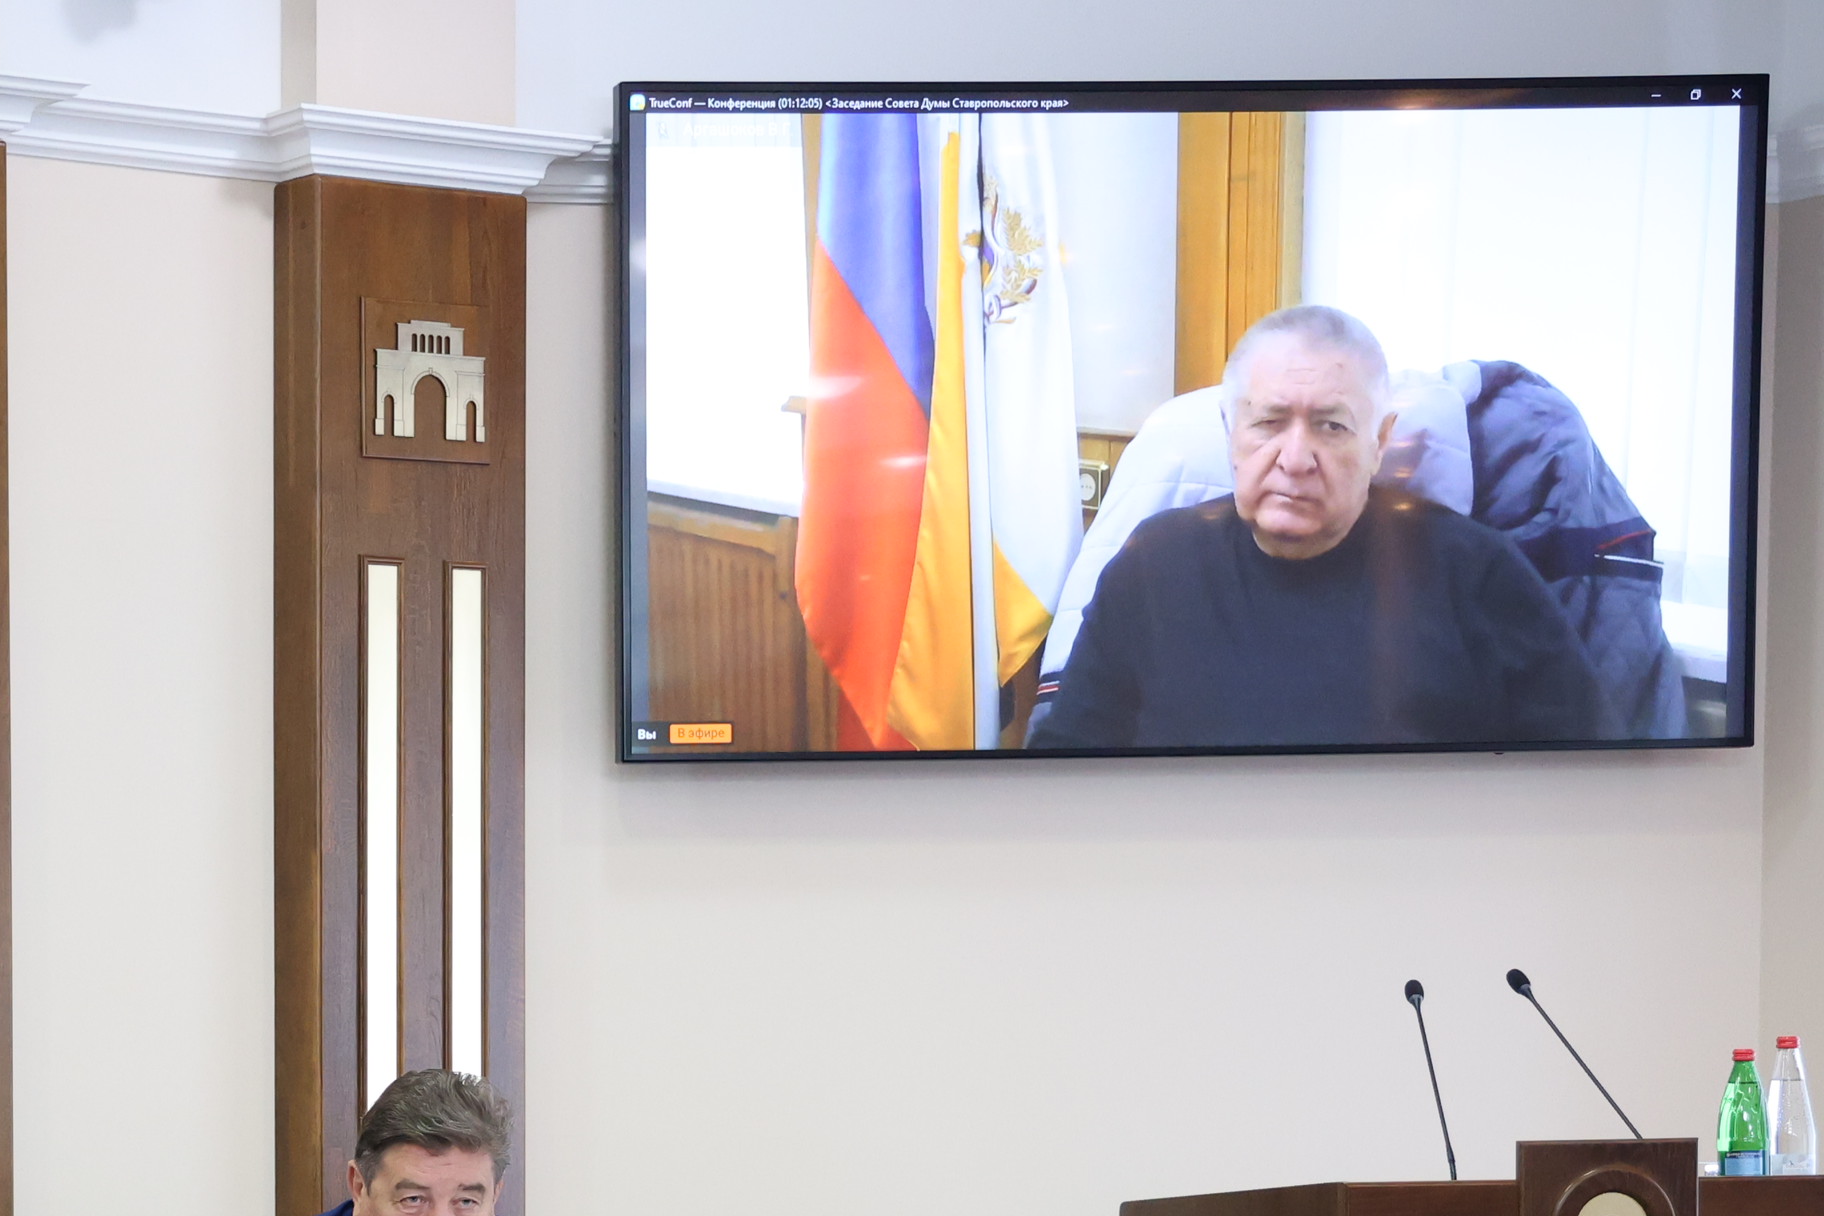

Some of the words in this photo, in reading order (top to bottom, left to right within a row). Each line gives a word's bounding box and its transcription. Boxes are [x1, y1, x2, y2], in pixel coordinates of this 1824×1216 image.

[649, 97, 693, 109] TrueConf
[708, 97, 776, 111] Конференция
[778, 97, 823, 110] (01:12:05)
[825, 97, 883, 110] <Заседание
[885, 97, 919, 108] Совета
[920, 97, 950, 111] Думы
[952, 97, 1039, 111] Ставропольского
[1041, 98, 1069, 110] края>
[637, 728, 657, 740] Вы
[677, 727, 686, 738] В
[688, 727, 725, 740] эфире
